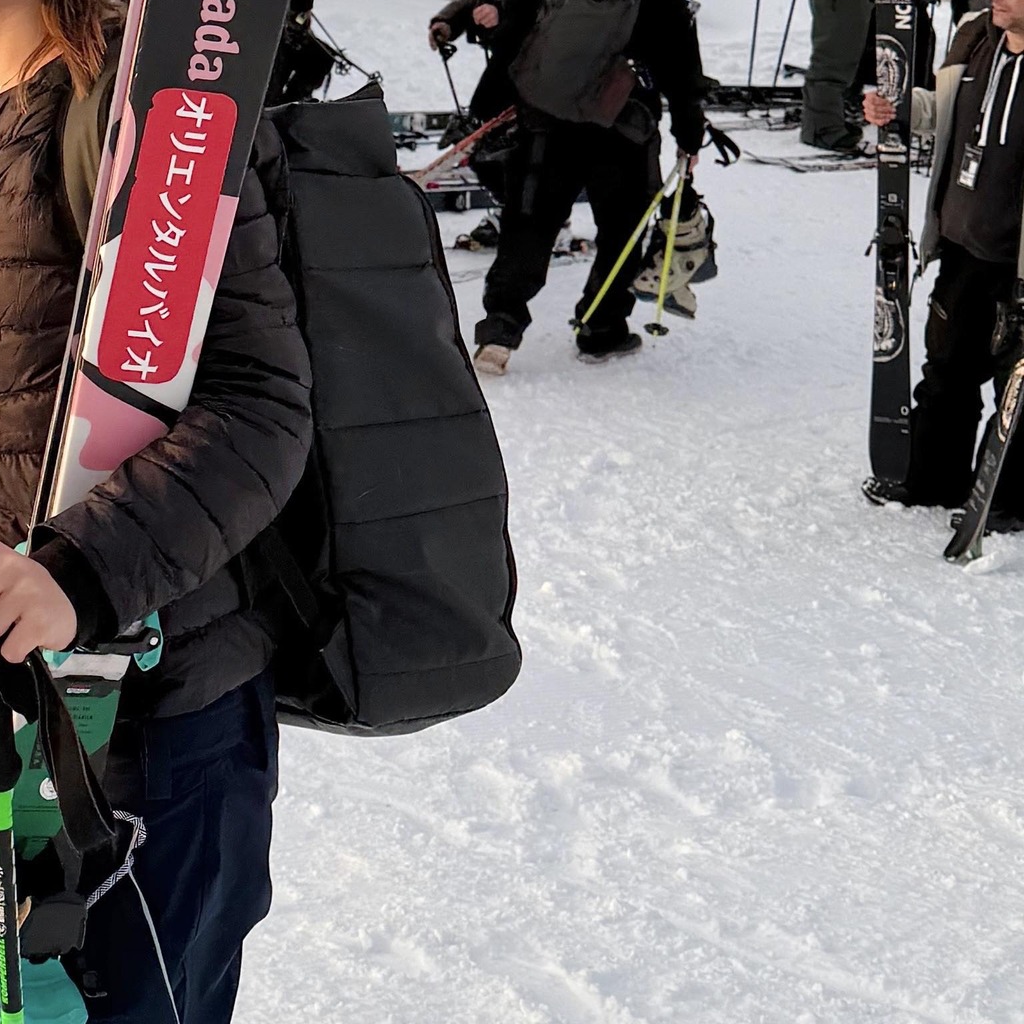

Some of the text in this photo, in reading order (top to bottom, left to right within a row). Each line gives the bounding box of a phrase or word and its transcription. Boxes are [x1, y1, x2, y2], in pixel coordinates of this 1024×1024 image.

[120, 91, 214, 381] オリエンタルバイオ
